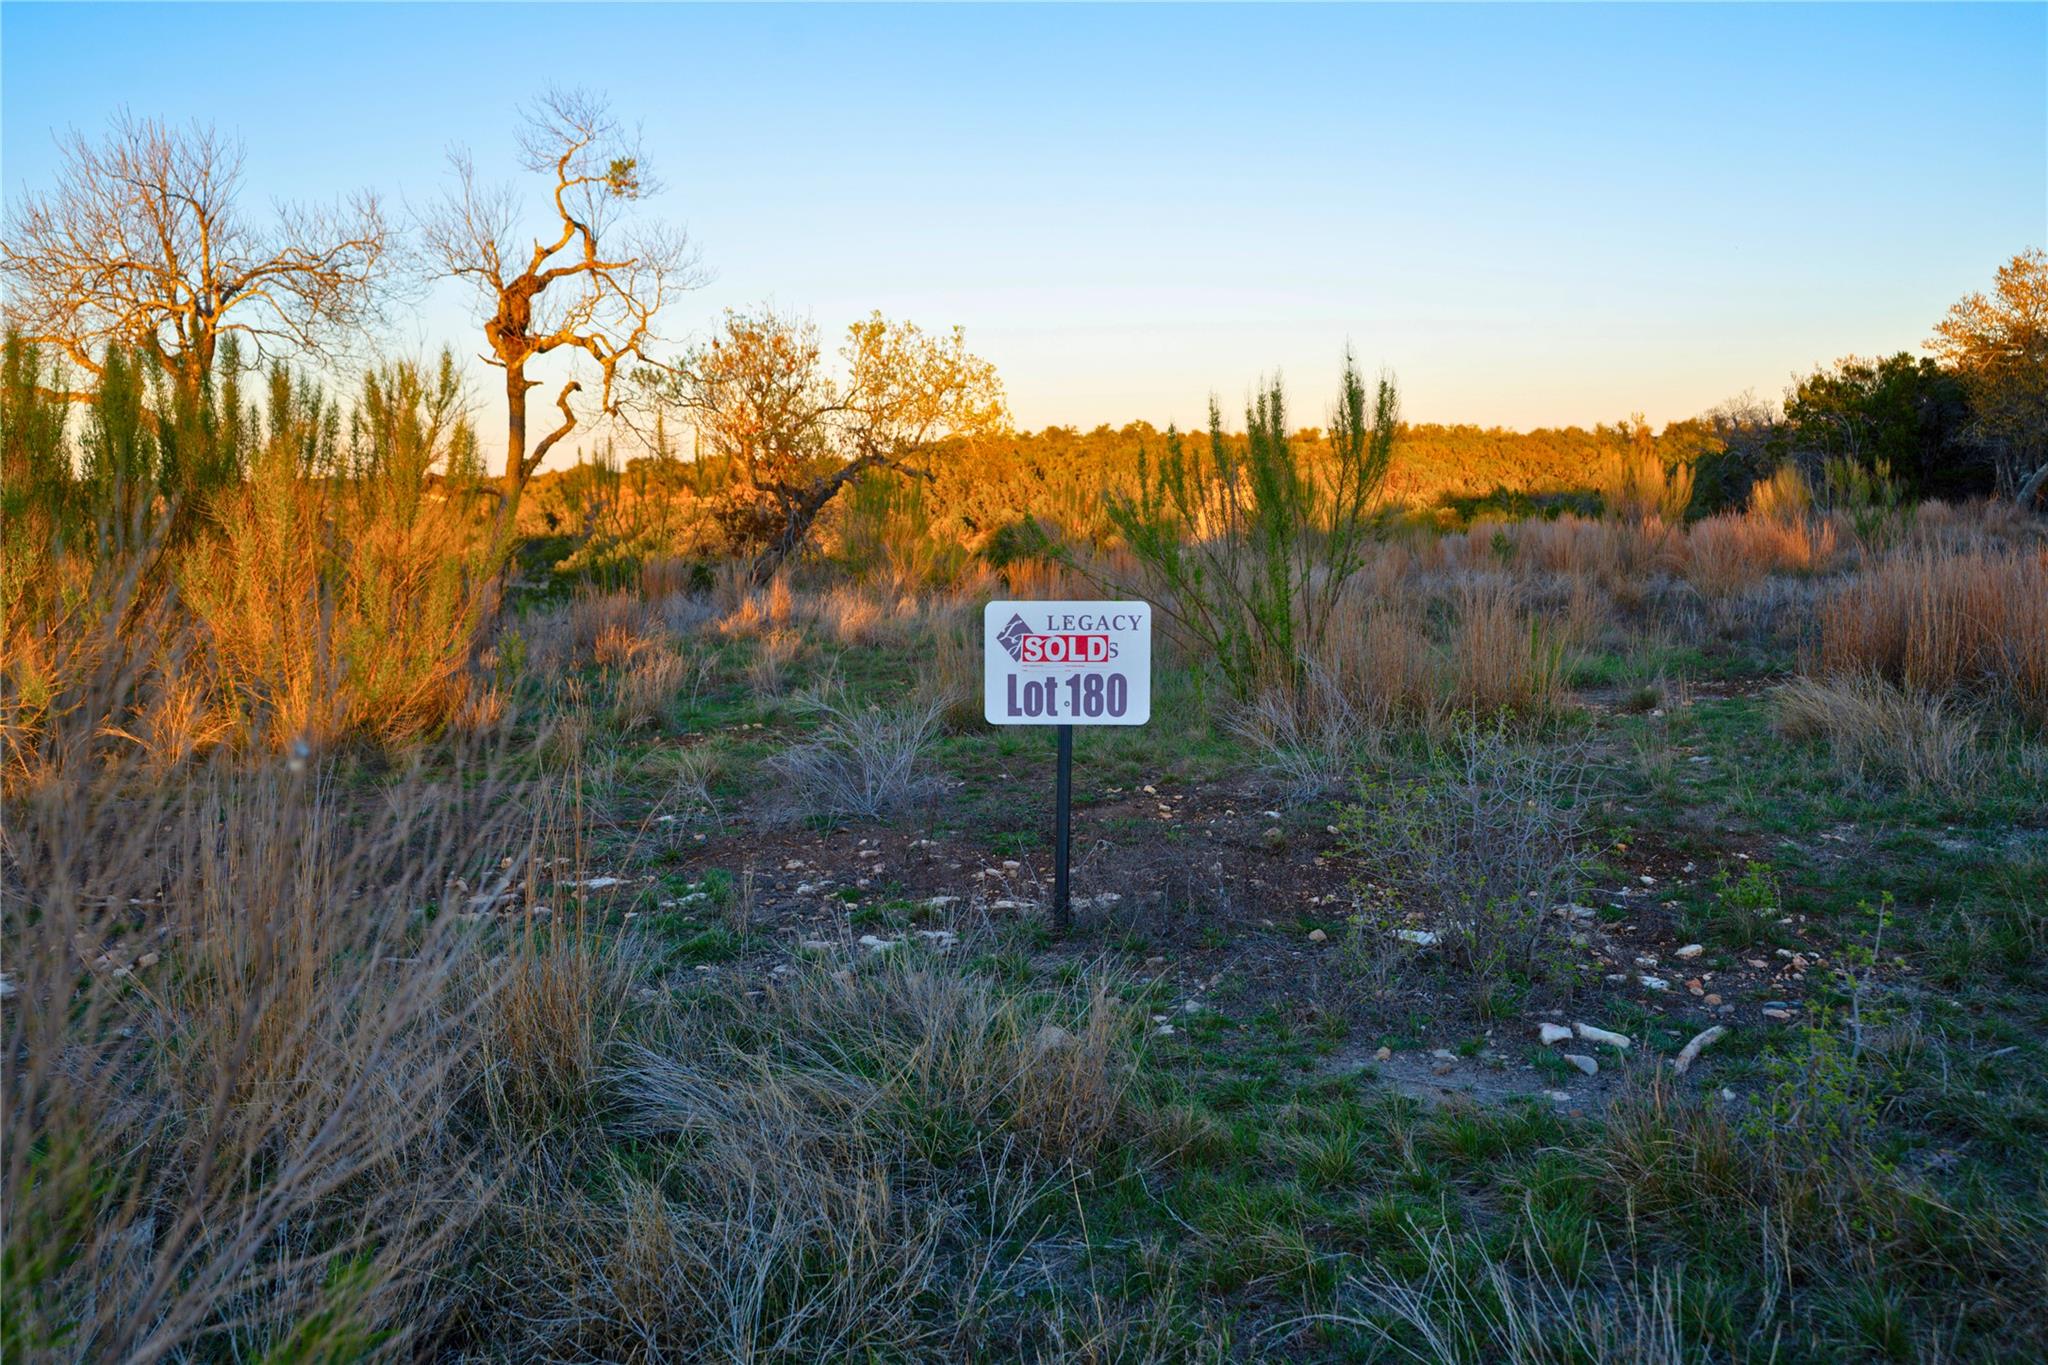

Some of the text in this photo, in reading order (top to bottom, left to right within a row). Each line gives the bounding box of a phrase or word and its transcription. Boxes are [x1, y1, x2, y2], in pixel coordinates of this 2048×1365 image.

[1047, 615, 1143, 631] LEGACY
[1024, 636, 1108, 662] SOLD
[1007, 673, 1127, 717] Lot 180
